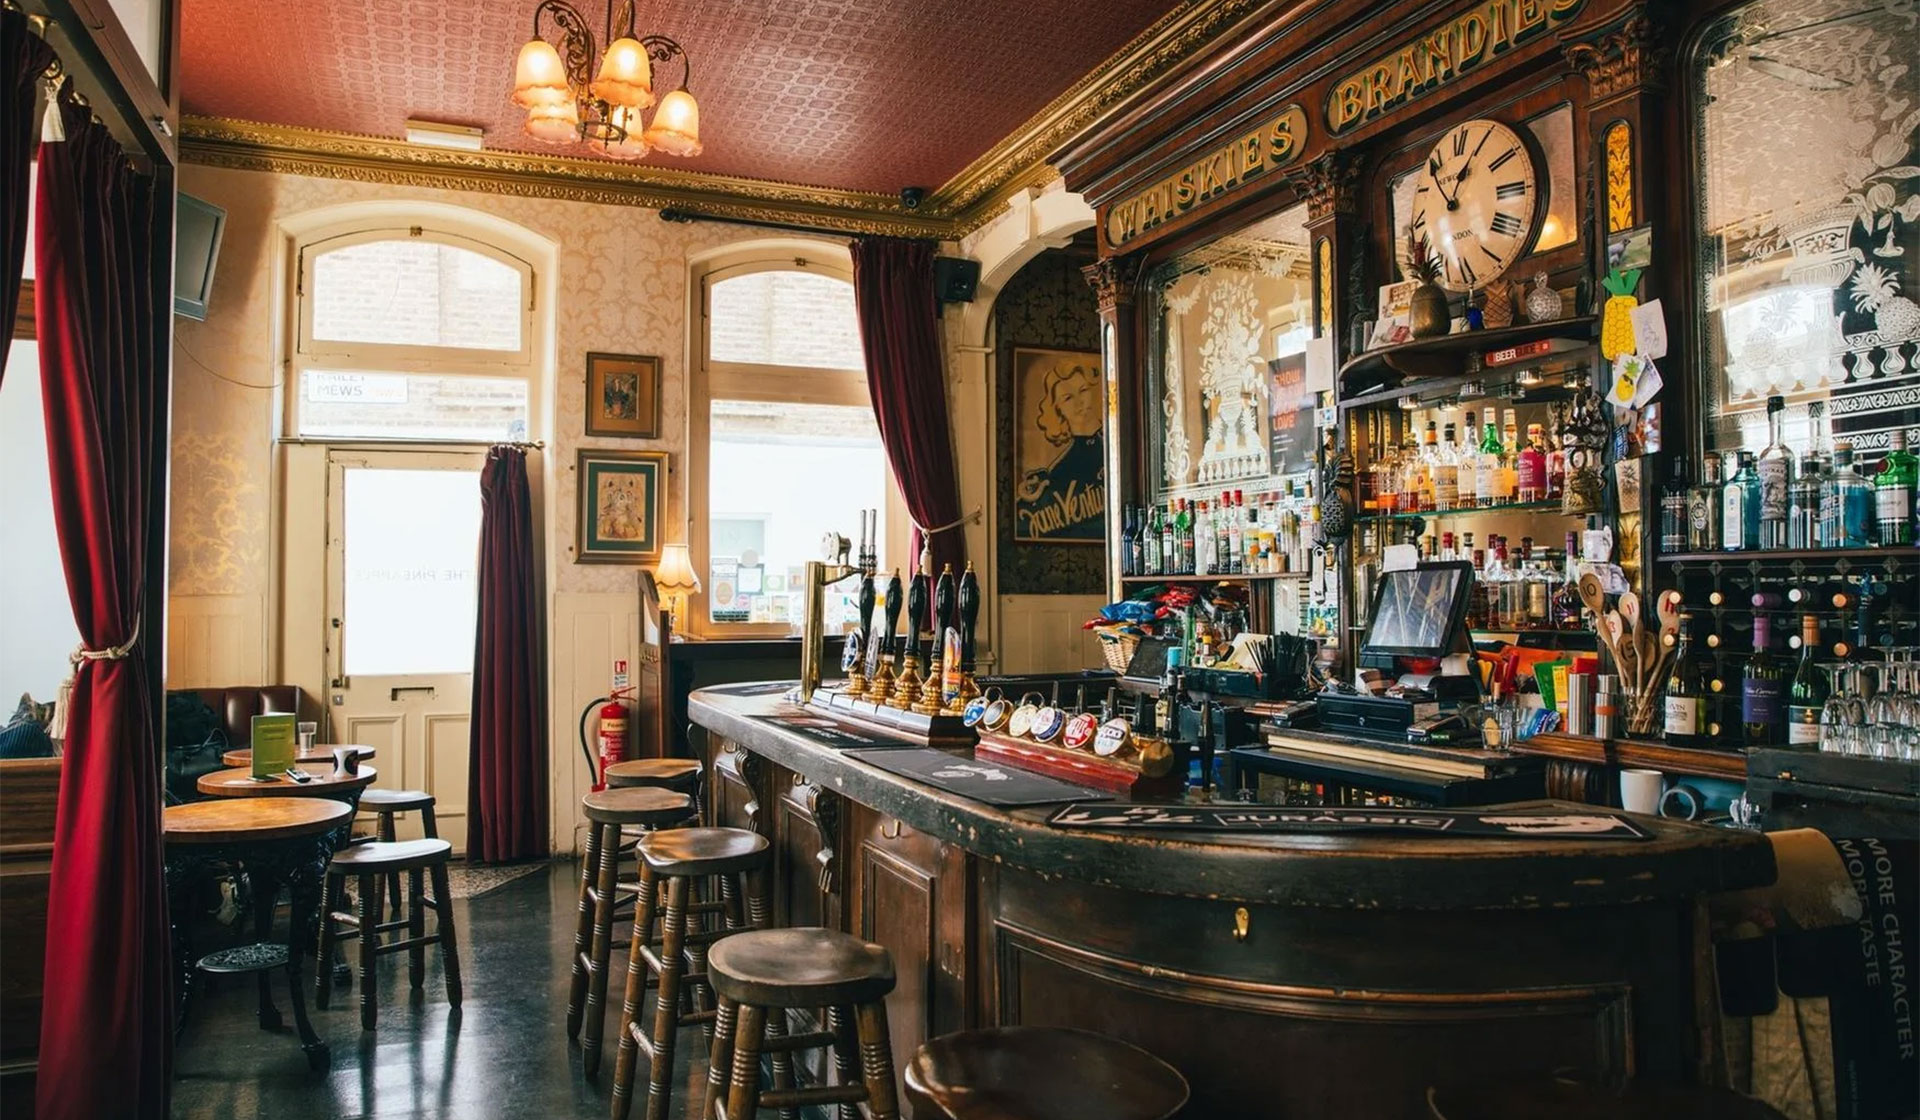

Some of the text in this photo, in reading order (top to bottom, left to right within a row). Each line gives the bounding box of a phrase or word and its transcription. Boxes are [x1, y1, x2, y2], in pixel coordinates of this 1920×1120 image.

[1336, 0, 1577, 132] BRANDIE
[1115, 114, 1295, 242] WHISKIES
[1495, 348, 1516, 362] BEER
[316, 384, 363, 397] MEWS
[1272, 412, 1297, 432] LOVE
[1582, 583, 1597, 597] 10
[1225, 814, 1441, 826] JURASSIC
[1859, 917, 1881, 986] TASTE
[1863, 838, 1914, 1060] MORE CHARACTER
